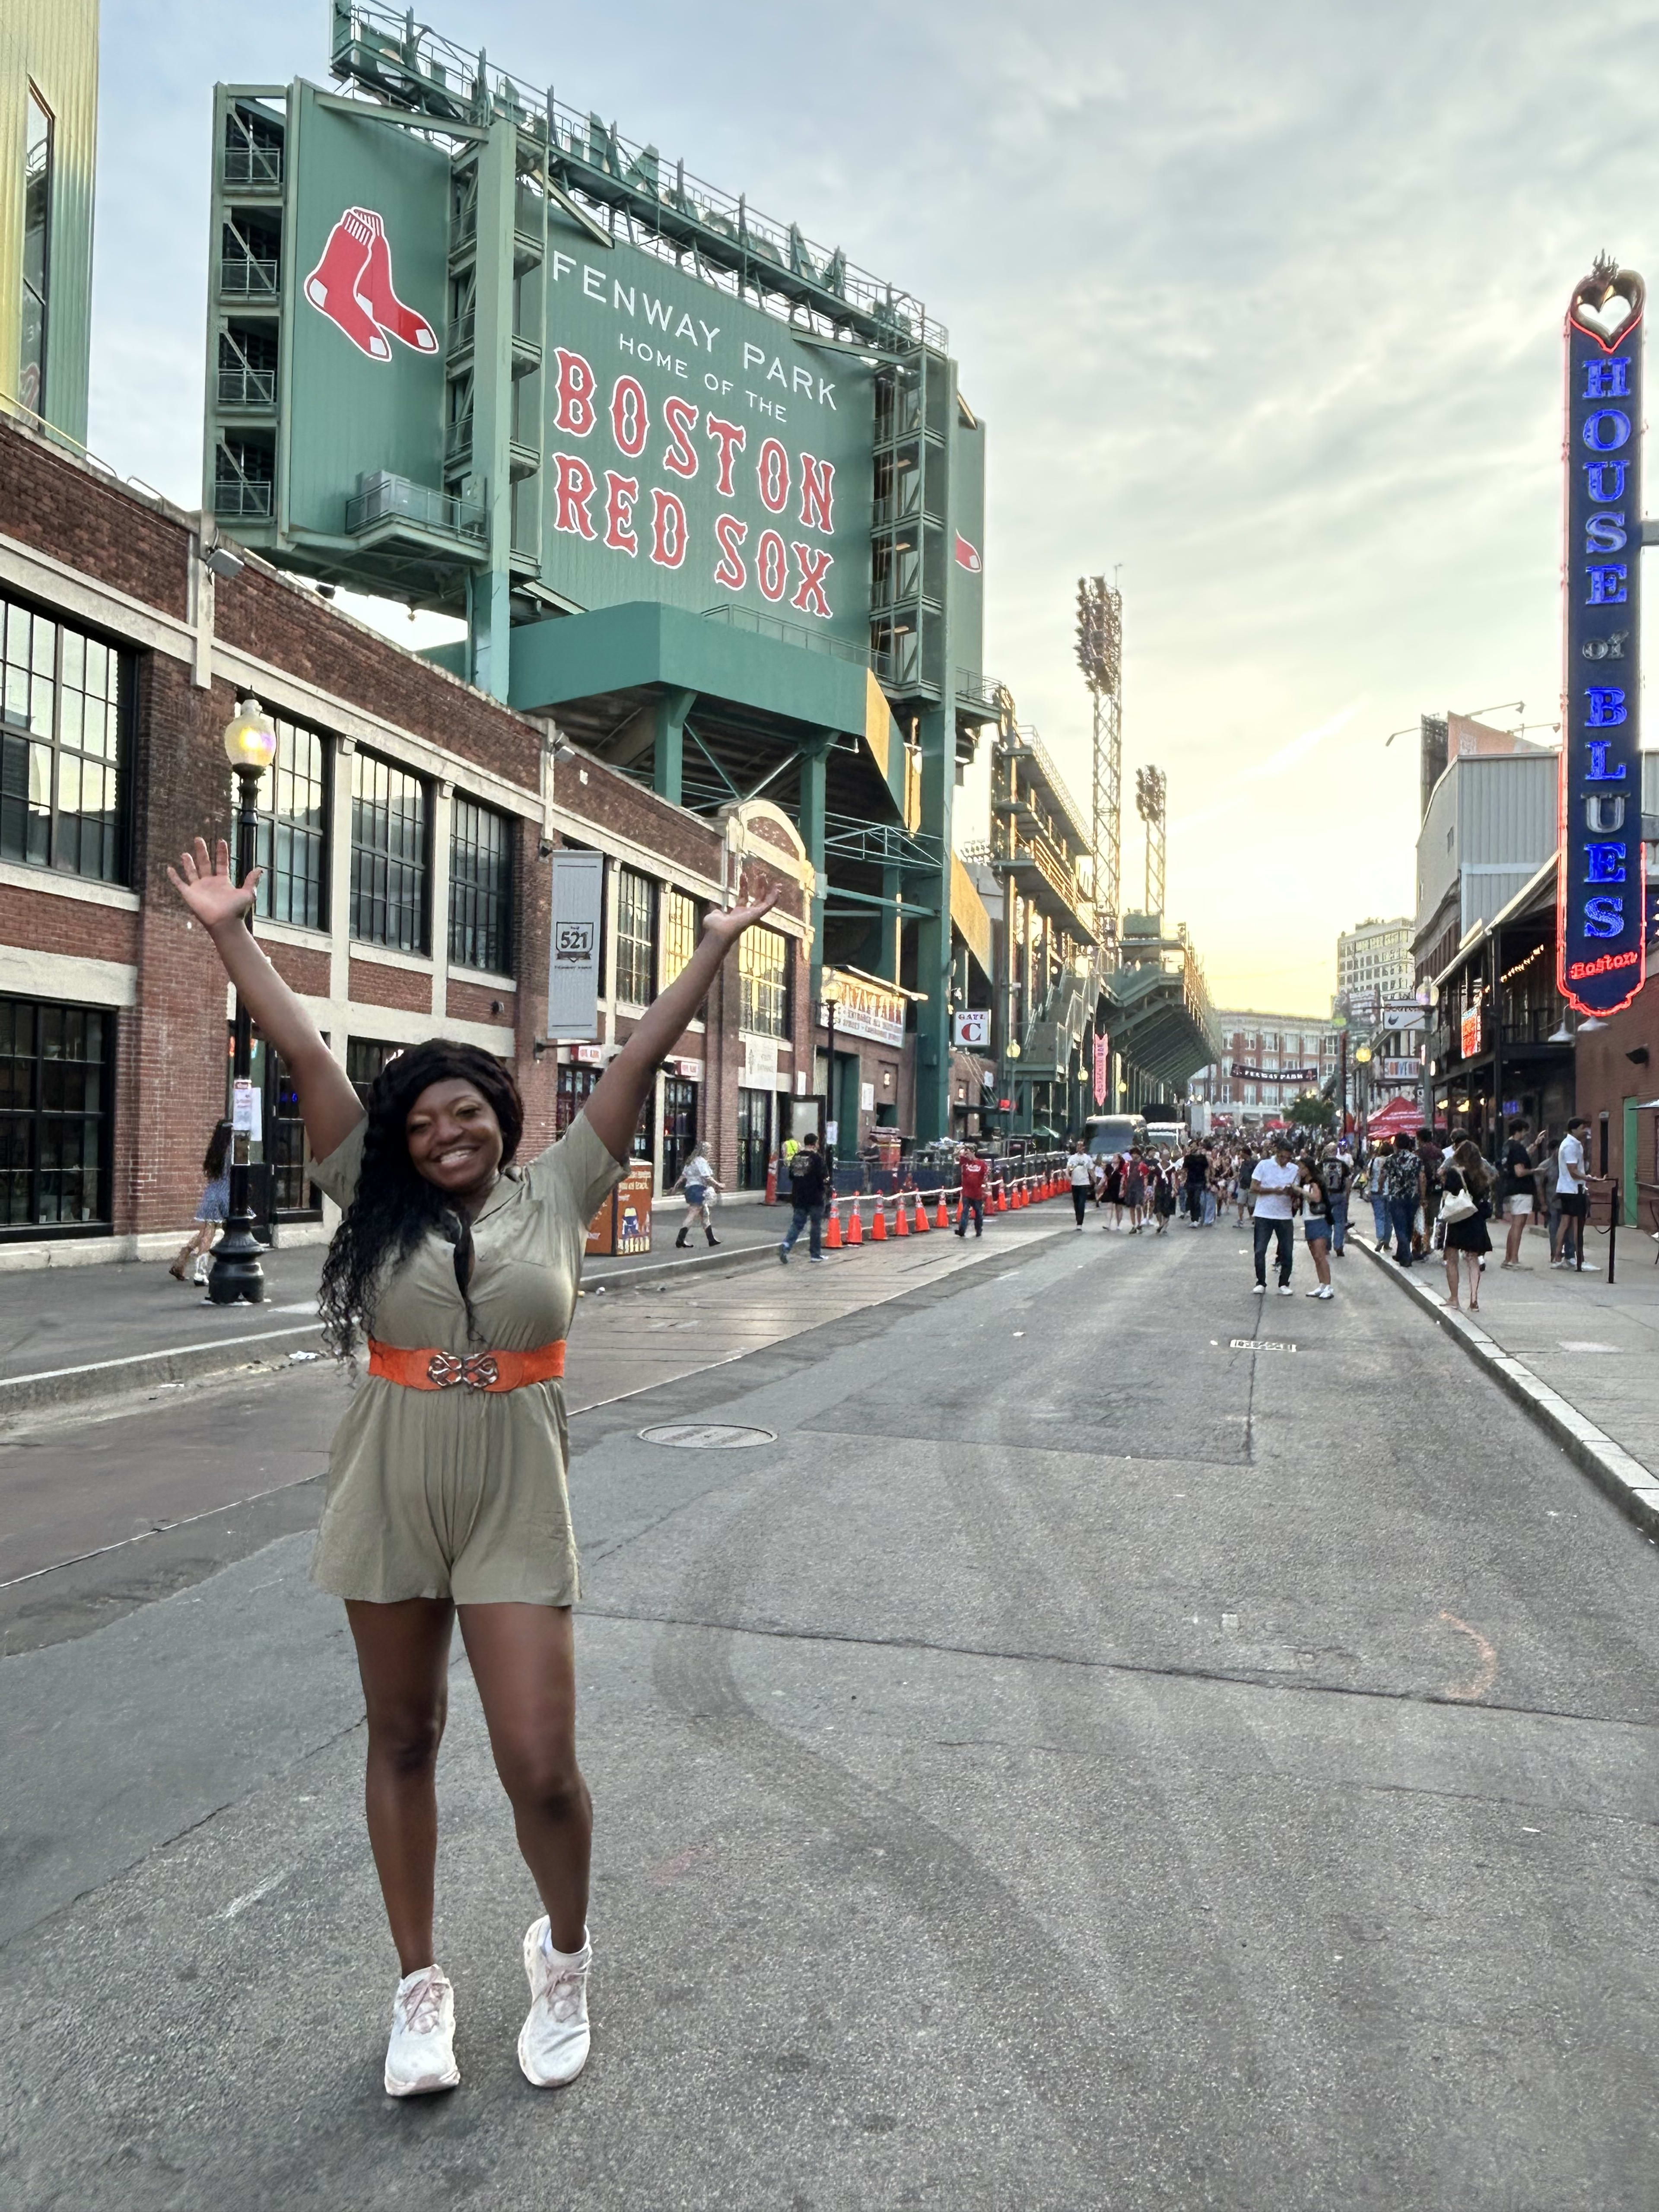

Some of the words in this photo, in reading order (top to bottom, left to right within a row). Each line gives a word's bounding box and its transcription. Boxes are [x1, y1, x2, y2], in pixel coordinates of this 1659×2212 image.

[552, 250, 720, 352] FENWAY
[744, 341, 837, 411] PARK
[620, 333, 688, 379] HOME
[704, 372, 734, 396] OF
[745, 392, 787, 423] THE
[553, 346, 836, 535] BOSTON
[1582, 357, 1631, 605] HOUSE
[552, 451, 690, 570] RED
[714, 512, 835, 619] SOX
[1580, 686, 1631, 938] BLUES
[561, 931, 588, 949] 521
[1569, 951, 1638, 980] Boston
[961, 1023, 981, 1042] C
